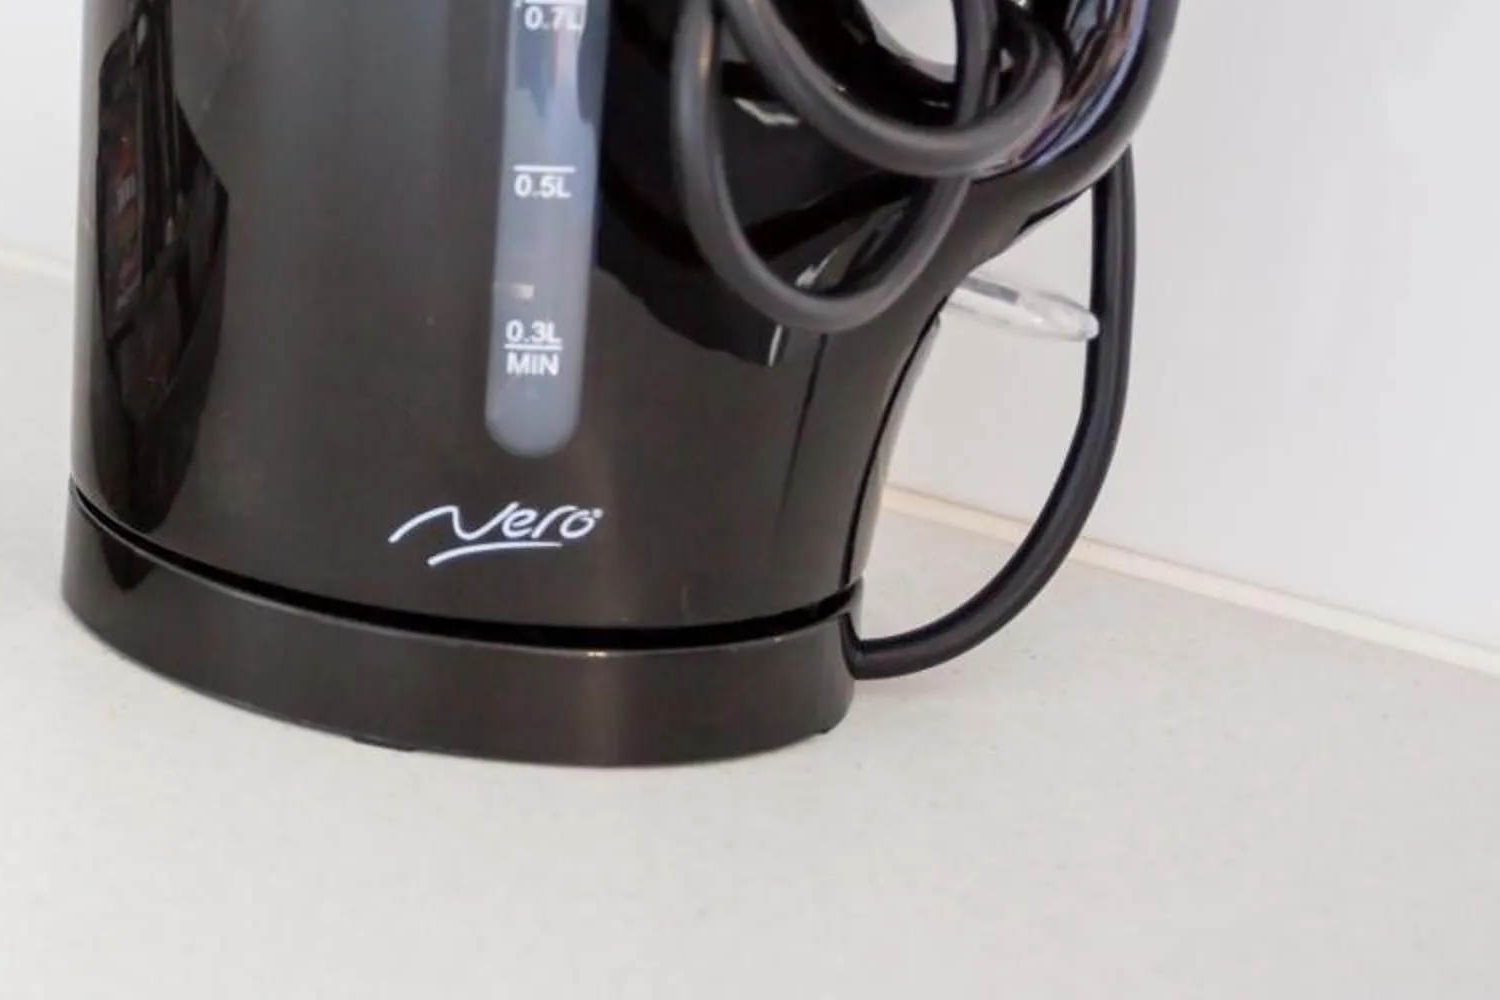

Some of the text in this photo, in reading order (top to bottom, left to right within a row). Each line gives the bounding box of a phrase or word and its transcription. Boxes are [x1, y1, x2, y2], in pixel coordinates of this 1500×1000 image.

[524, 7, 582, 31] 0.7L
[513, 173, 572, 199] 0.5L
[505, 320, 562, 345] 0.3L
[506, 352, 560, 376] MIN
[388, 501, 598, 544] Nero
